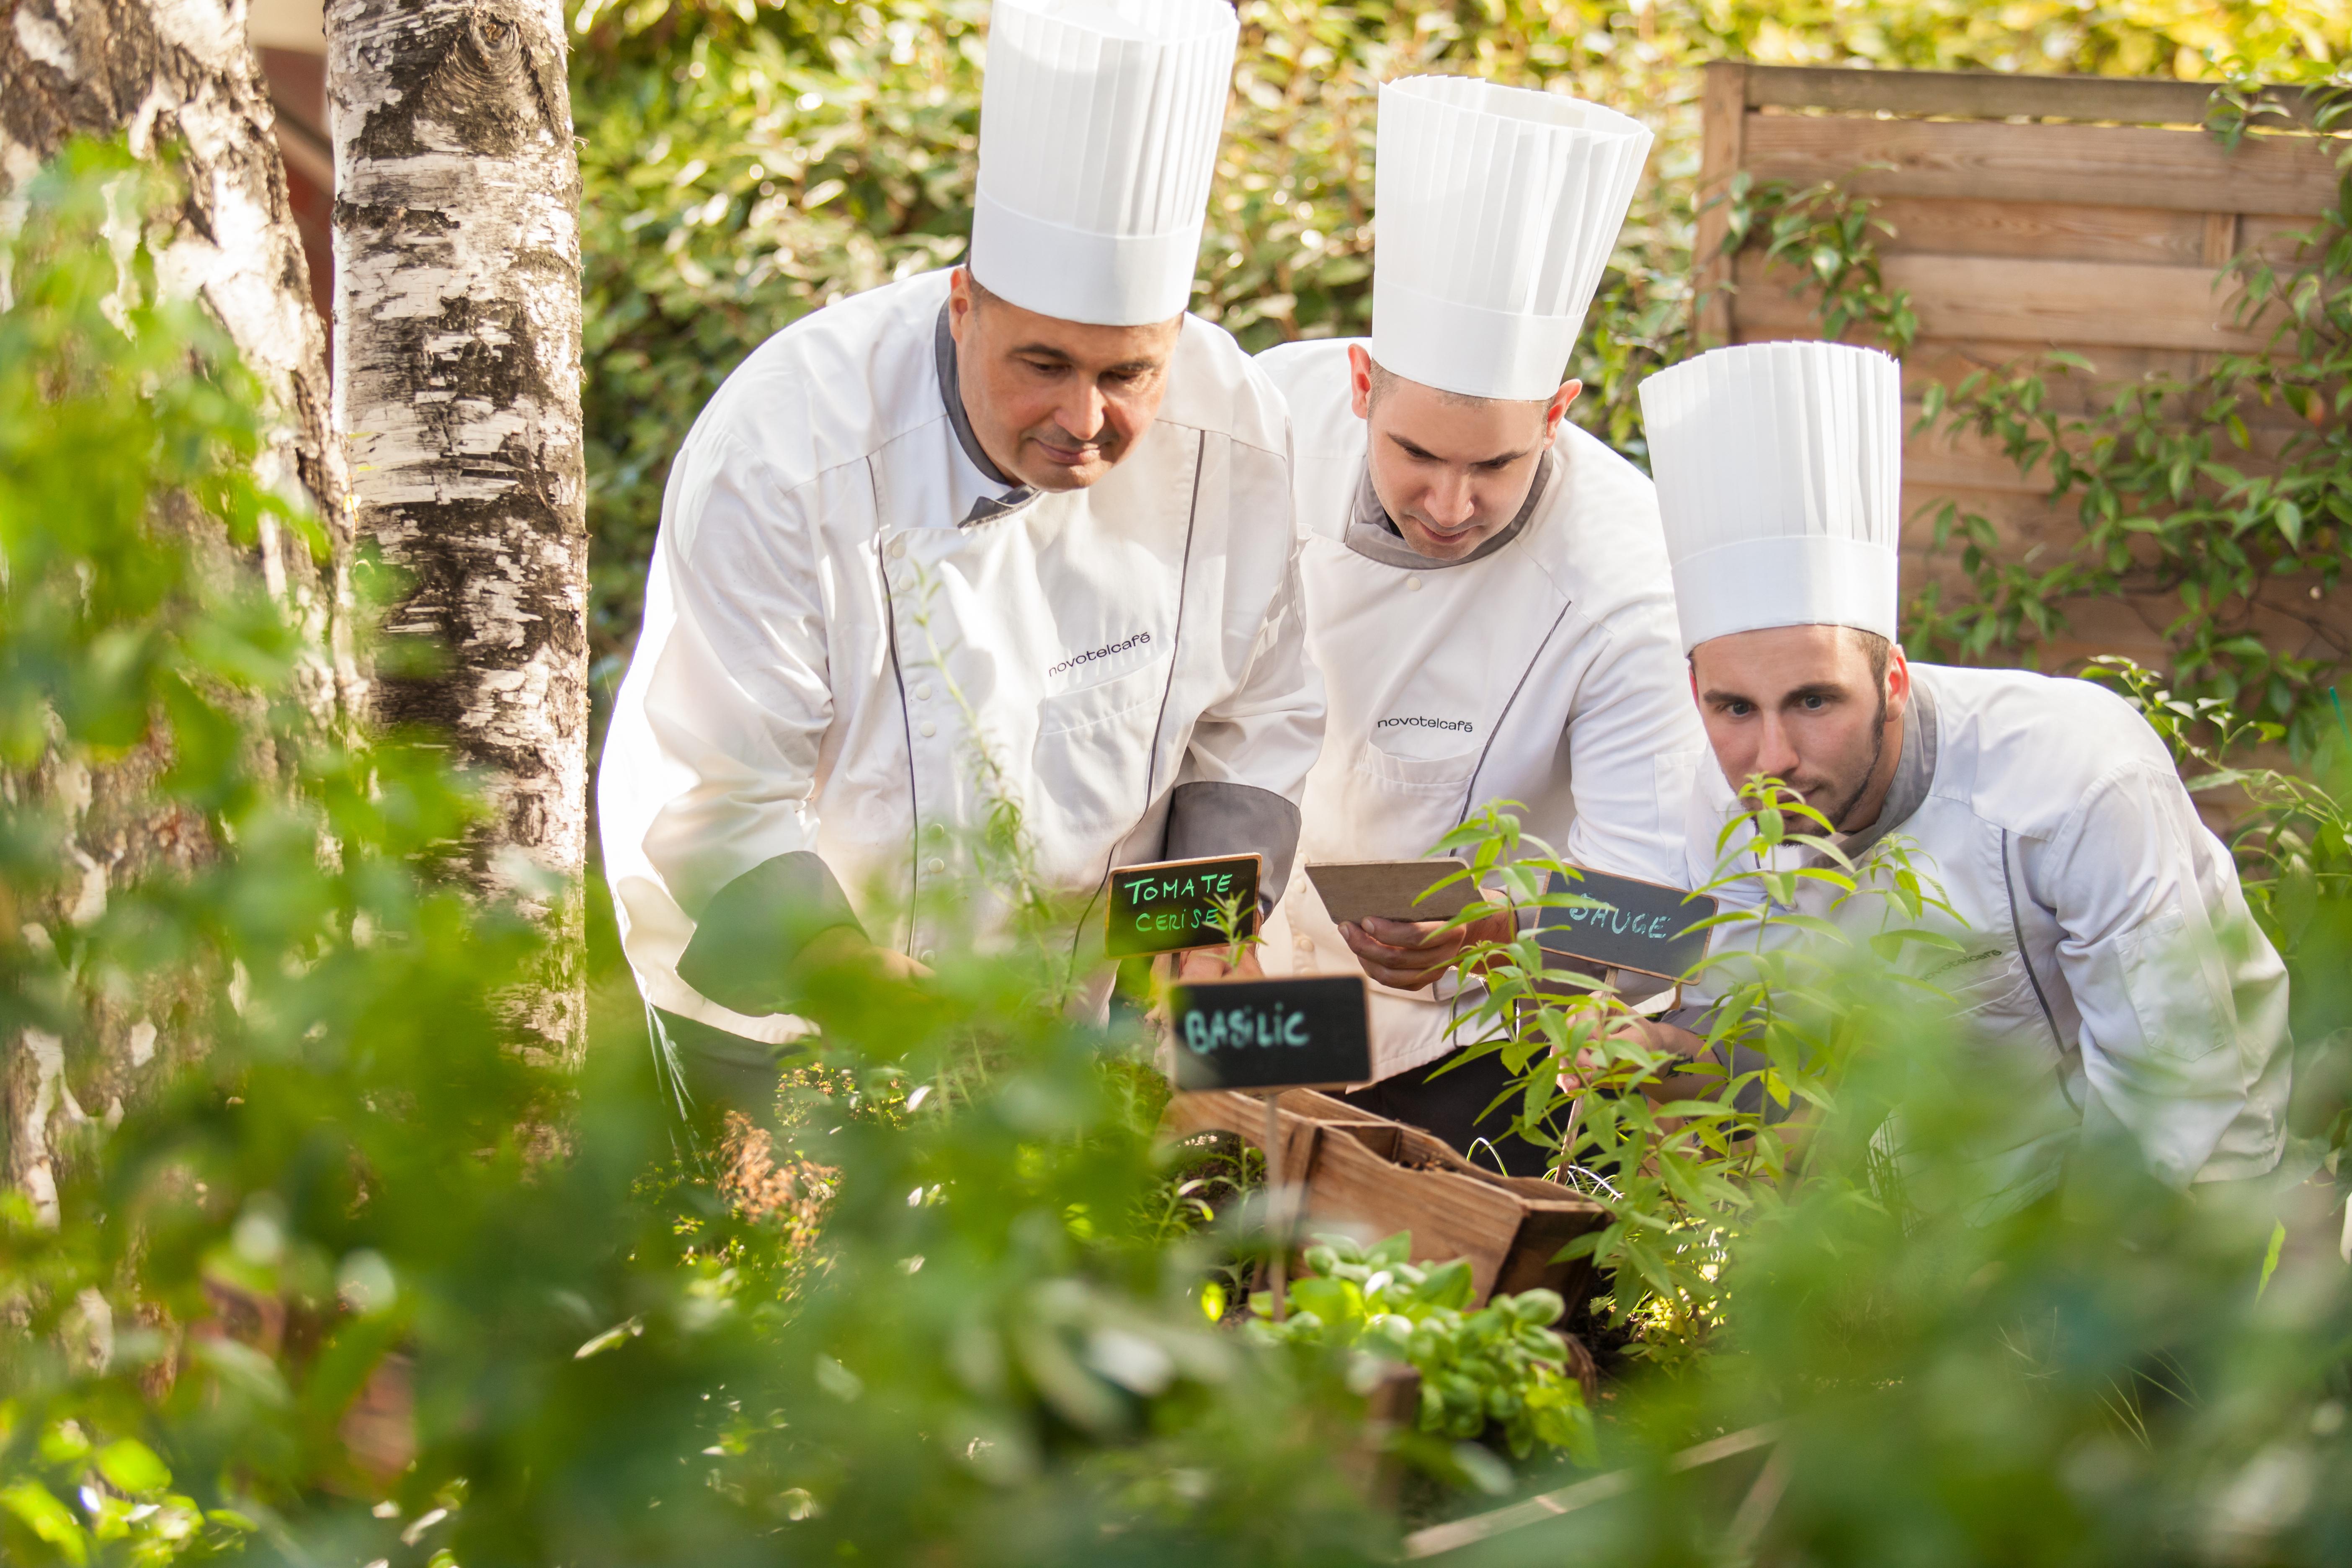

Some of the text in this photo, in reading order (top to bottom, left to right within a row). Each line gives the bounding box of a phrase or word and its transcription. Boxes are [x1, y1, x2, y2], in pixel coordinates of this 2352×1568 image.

[1049, 632, 1150, 677] novotelcafé
[1377, 716, 1473, 732] novotelcafé
[1124, 874, 1233, 904] TOMATE
[1569, 892, 1671, 939] SAUGE
